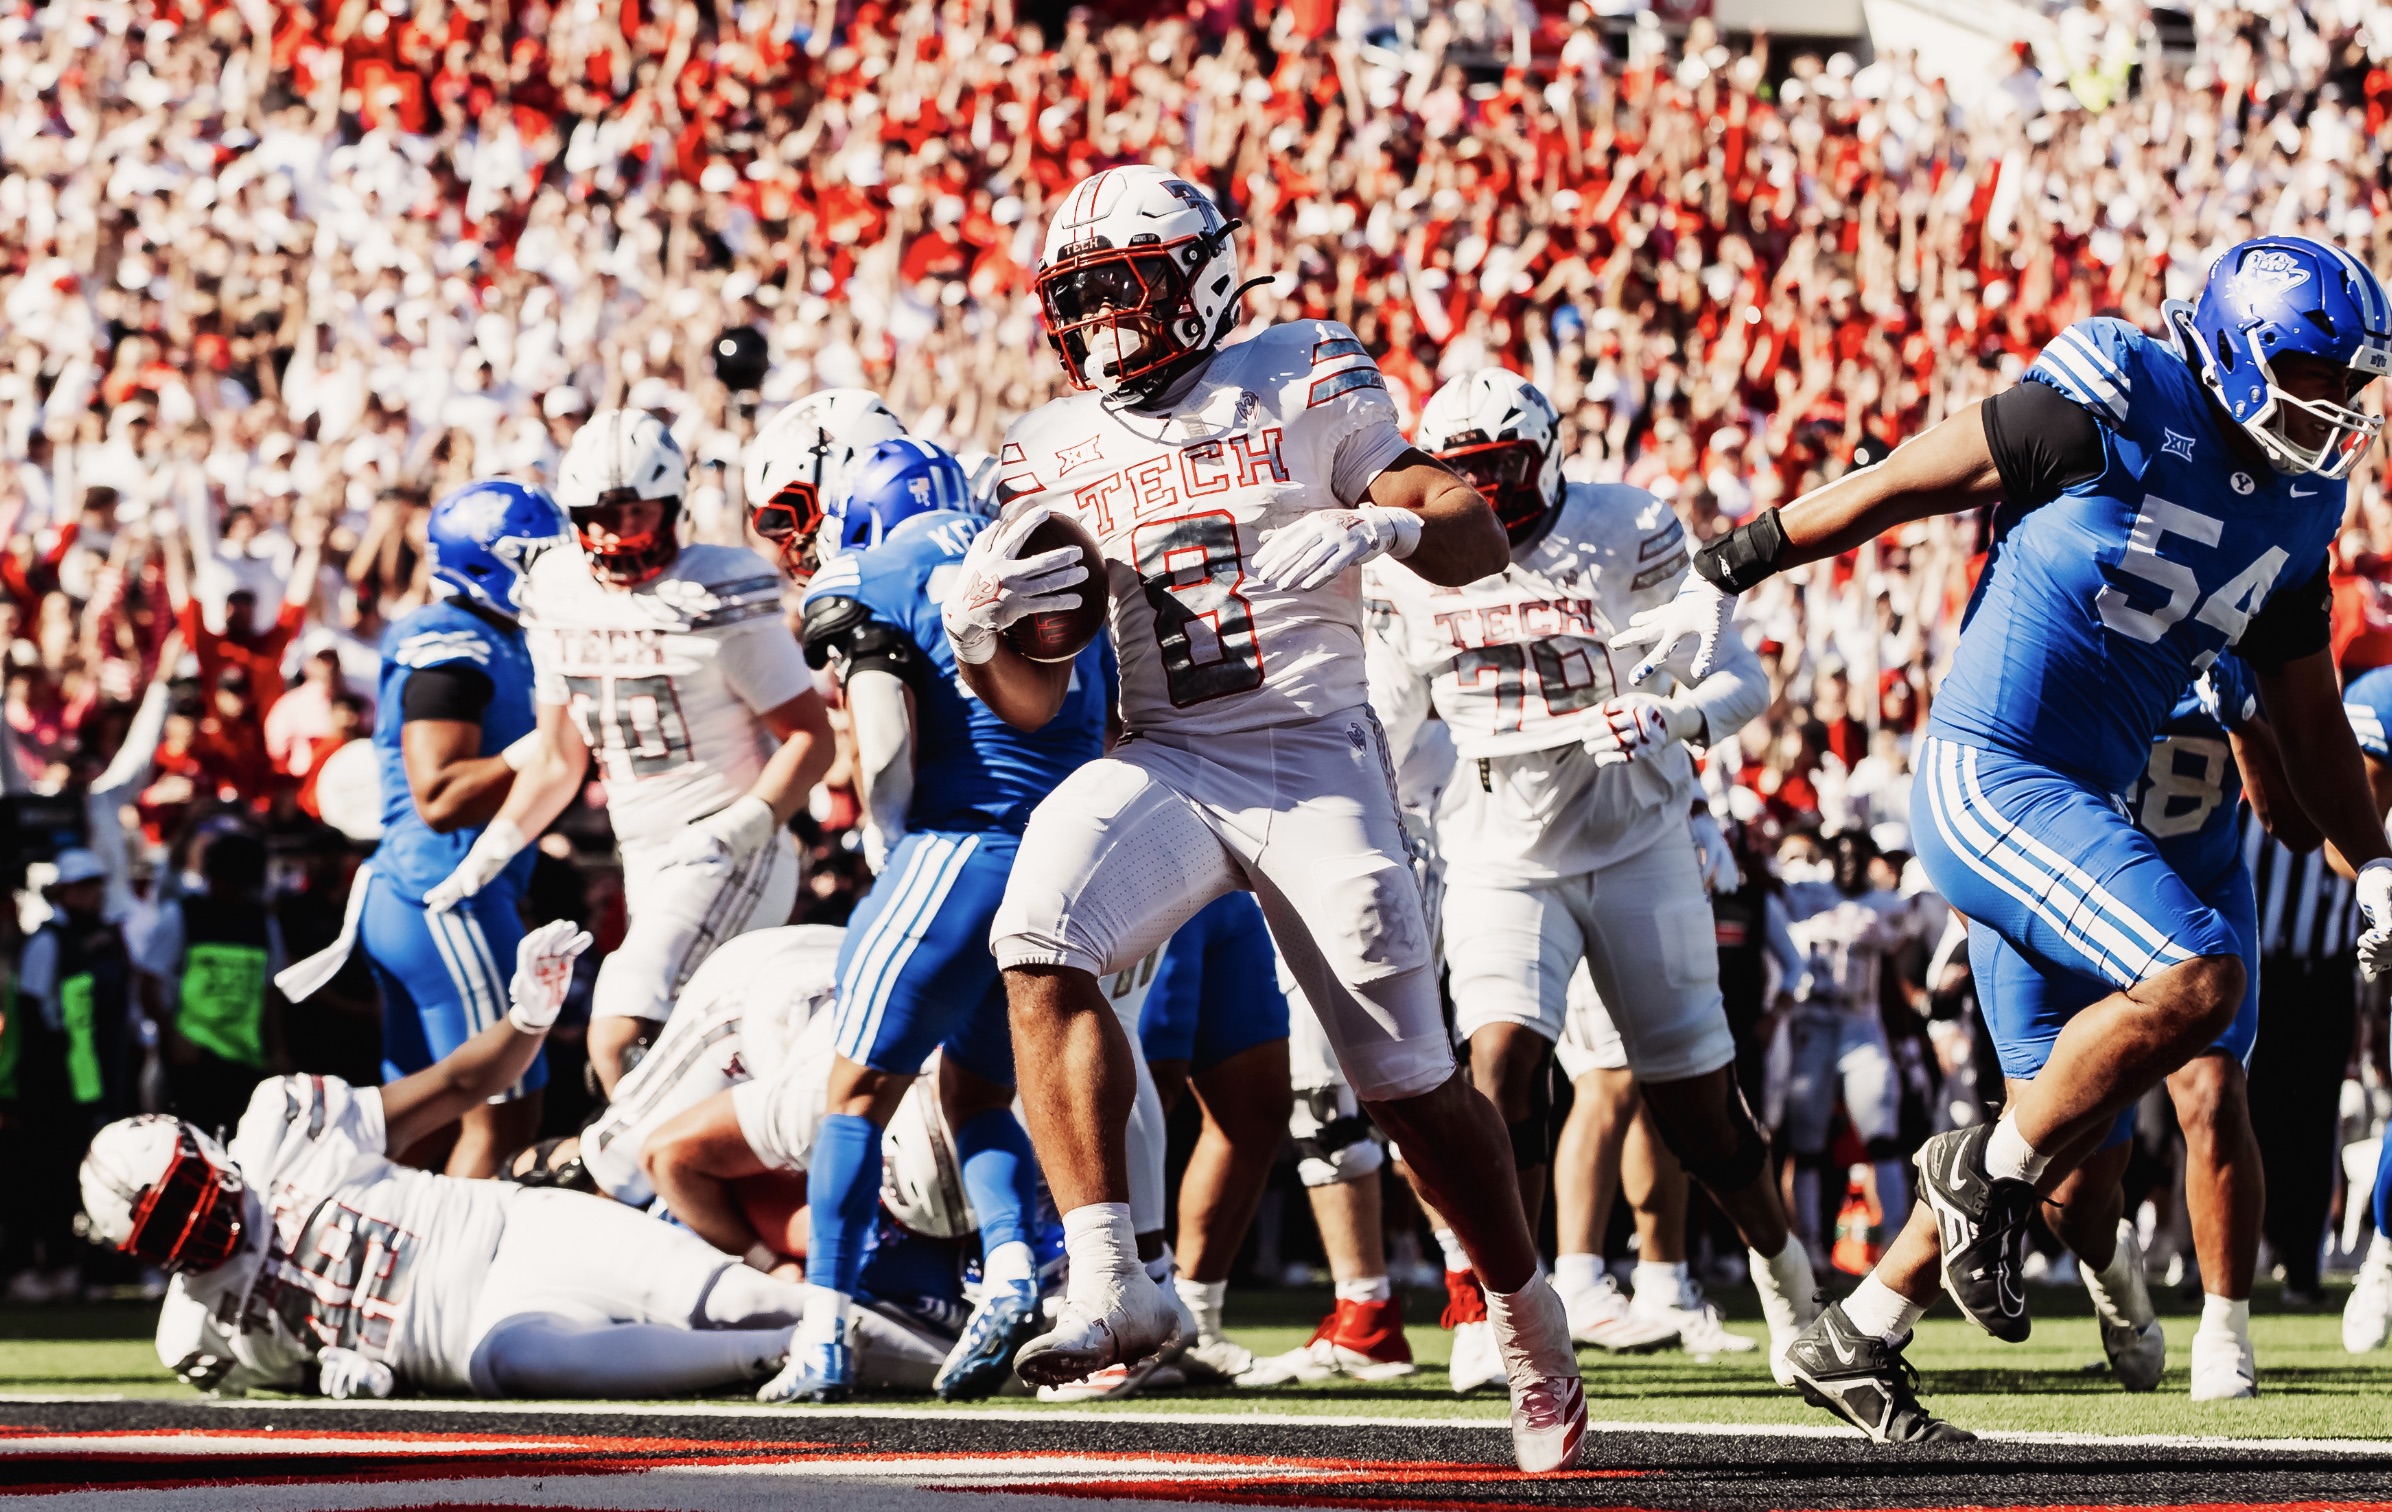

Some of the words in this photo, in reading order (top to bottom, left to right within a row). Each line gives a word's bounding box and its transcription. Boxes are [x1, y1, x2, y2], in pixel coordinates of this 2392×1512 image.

[1063, 237, 1099, 256] TECH
[1075, 427, 1291, 537] TECH
[2232, 472, 2253, 493] Y
[1131, 508, 1265, 709] 8
[1434, 597, 1595, 650] TECH
[2095, 493, 2290, 673] 54
[2127, 735, 2229, 839] 8
